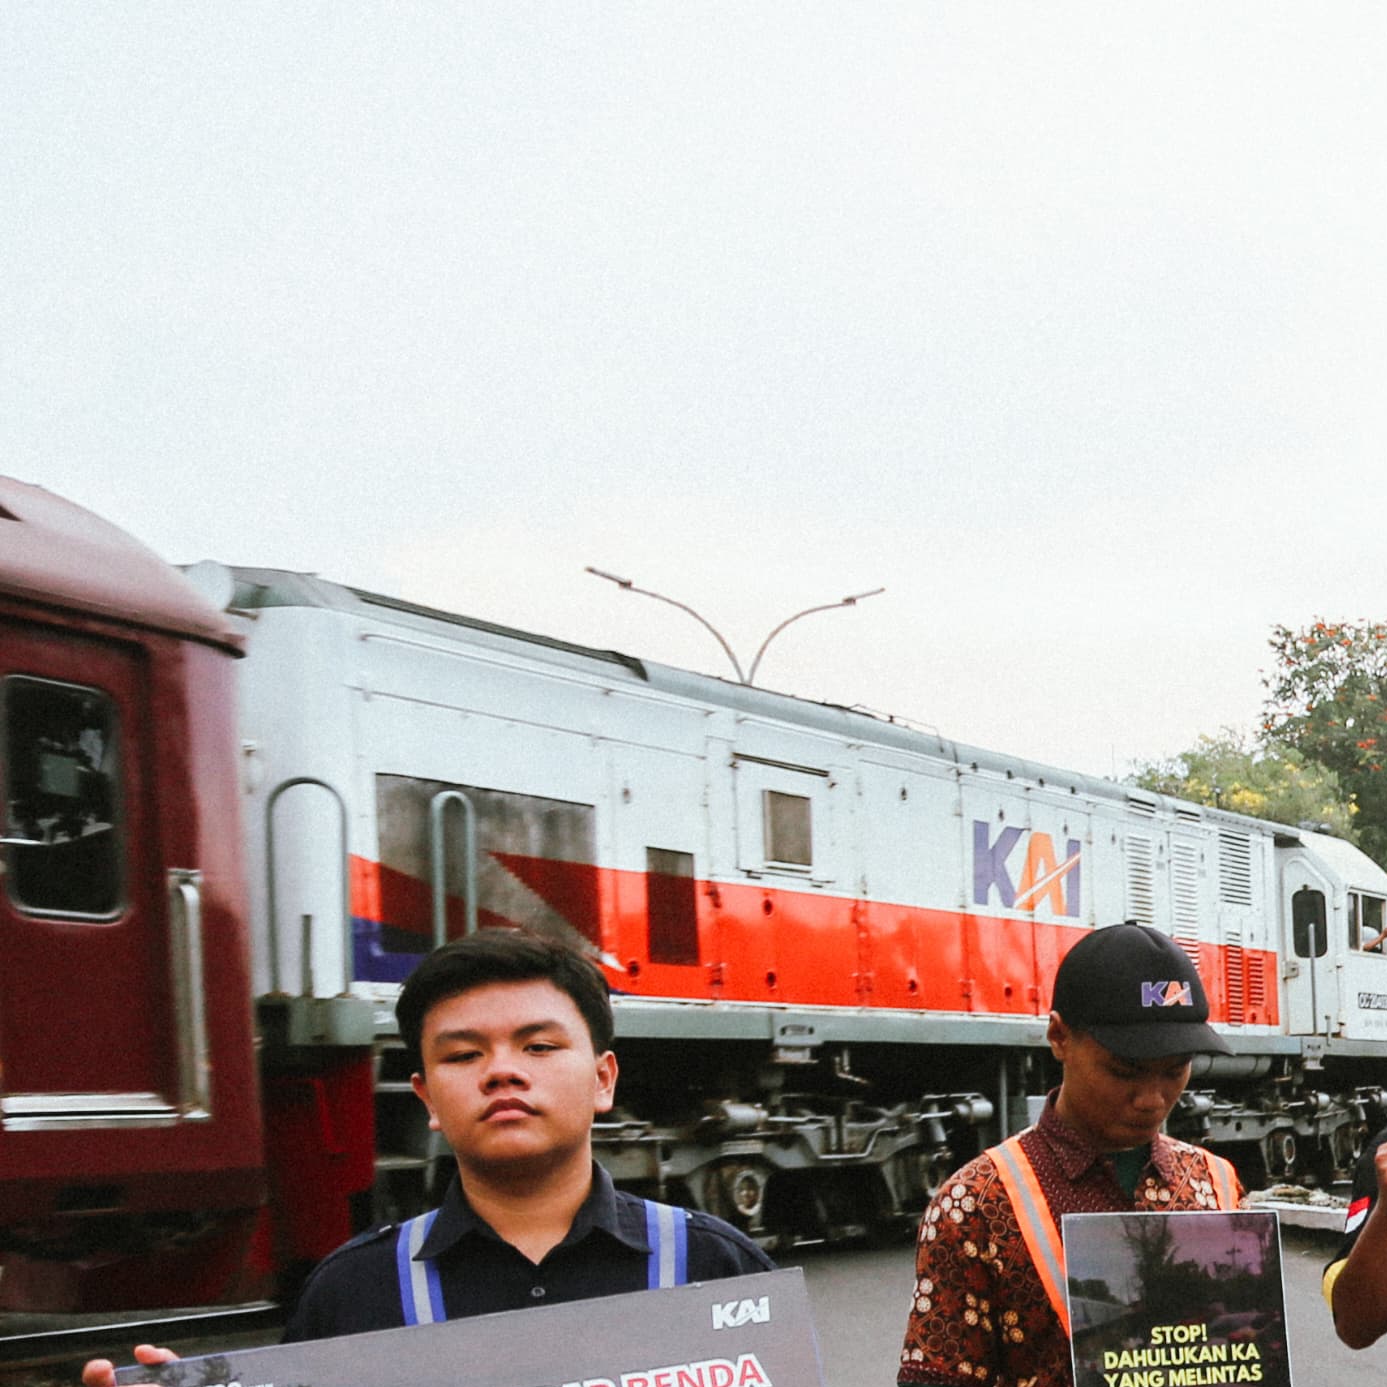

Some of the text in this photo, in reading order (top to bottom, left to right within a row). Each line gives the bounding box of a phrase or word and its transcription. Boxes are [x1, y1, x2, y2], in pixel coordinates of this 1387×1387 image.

[973, 820, 1081, 918] KAI
[1141, 981, 1192, 1007] KAI
[712, 1296, 771, 1330] KAI
[1150, 1323, 1207, 1344] STOP!
[1104, 1345, 1260, 1369] DAHULUKAN KA
[1168, 1363, 1263, 1387] MELINTAS
